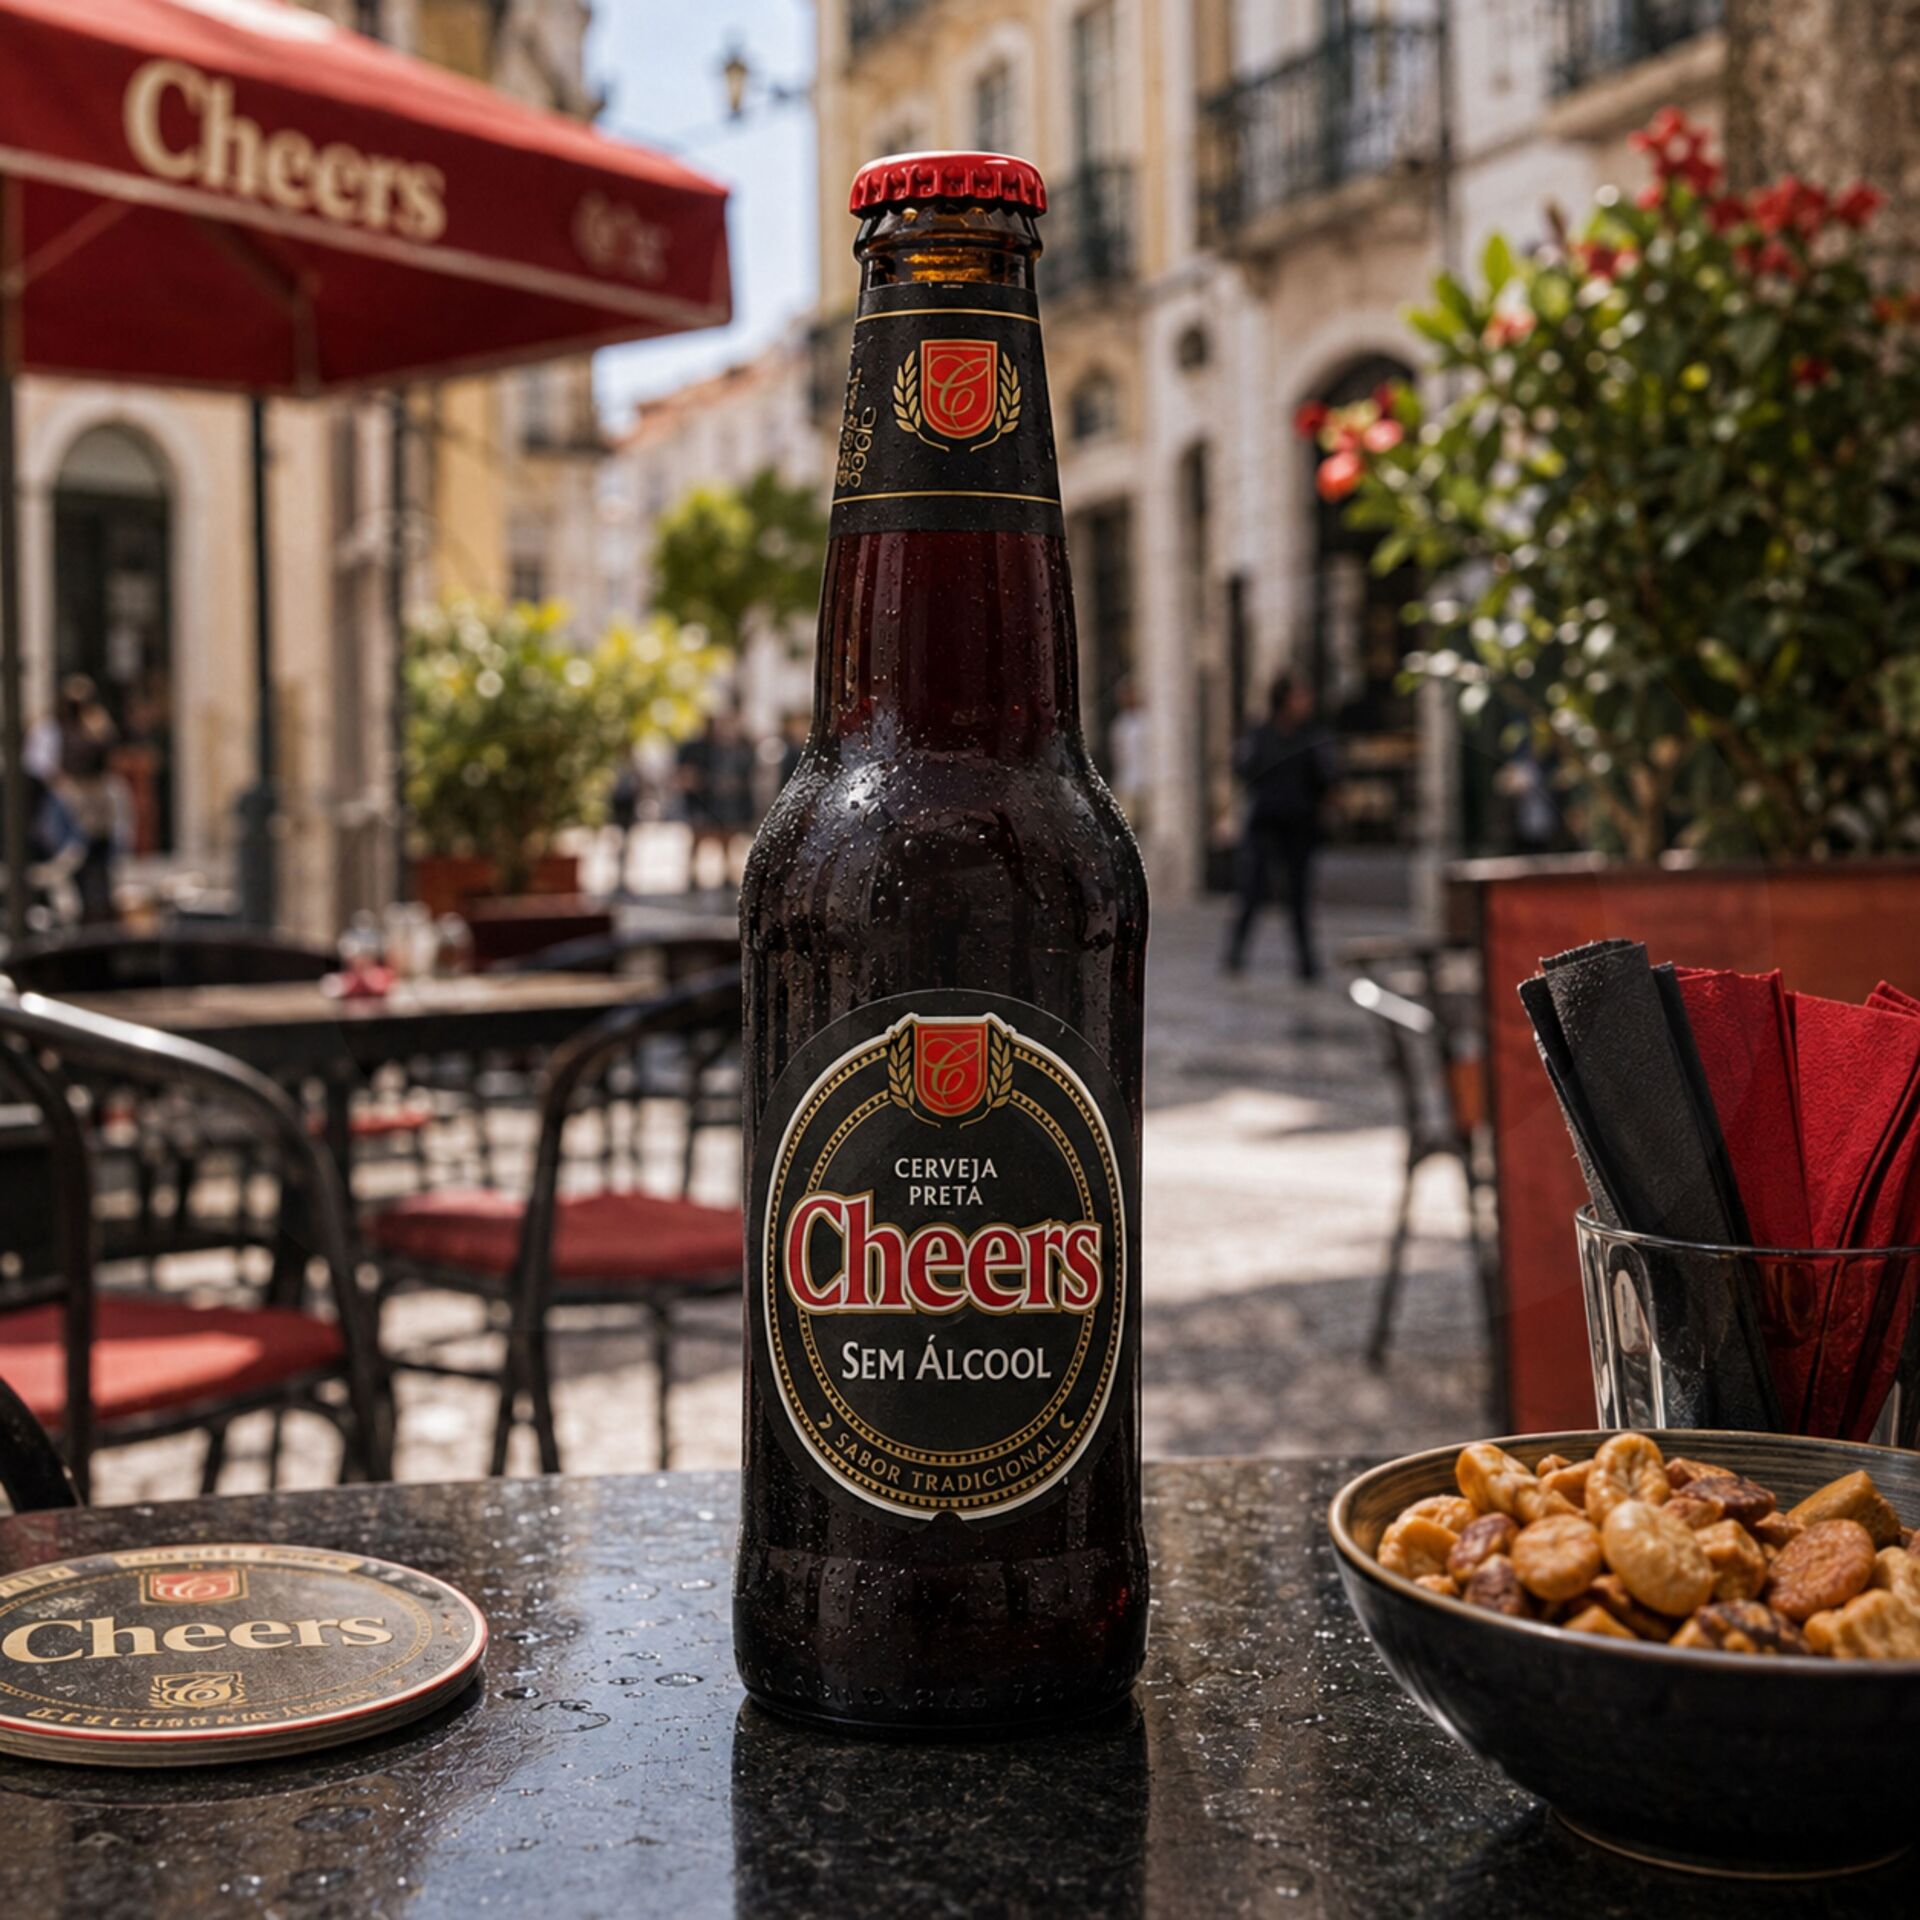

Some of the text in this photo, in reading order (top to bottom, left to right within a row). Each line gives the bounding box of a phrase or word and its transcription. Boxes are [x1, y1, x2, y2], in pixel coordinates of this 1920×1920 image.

[123, 59, 447, 242] Cheers
[894, 1157, 998, 1184] CERVEJA
[909, 1185, 984, 1206] PRETA
[784, 1189, 1102, 1316] Cheers
[841, 1334, 1052, 1381] SEM ÁLCOOL
[835, 1432, 1061, 1492] SABOR TRADICIONAL
[1, 1616, 394, 1664] Cheers
